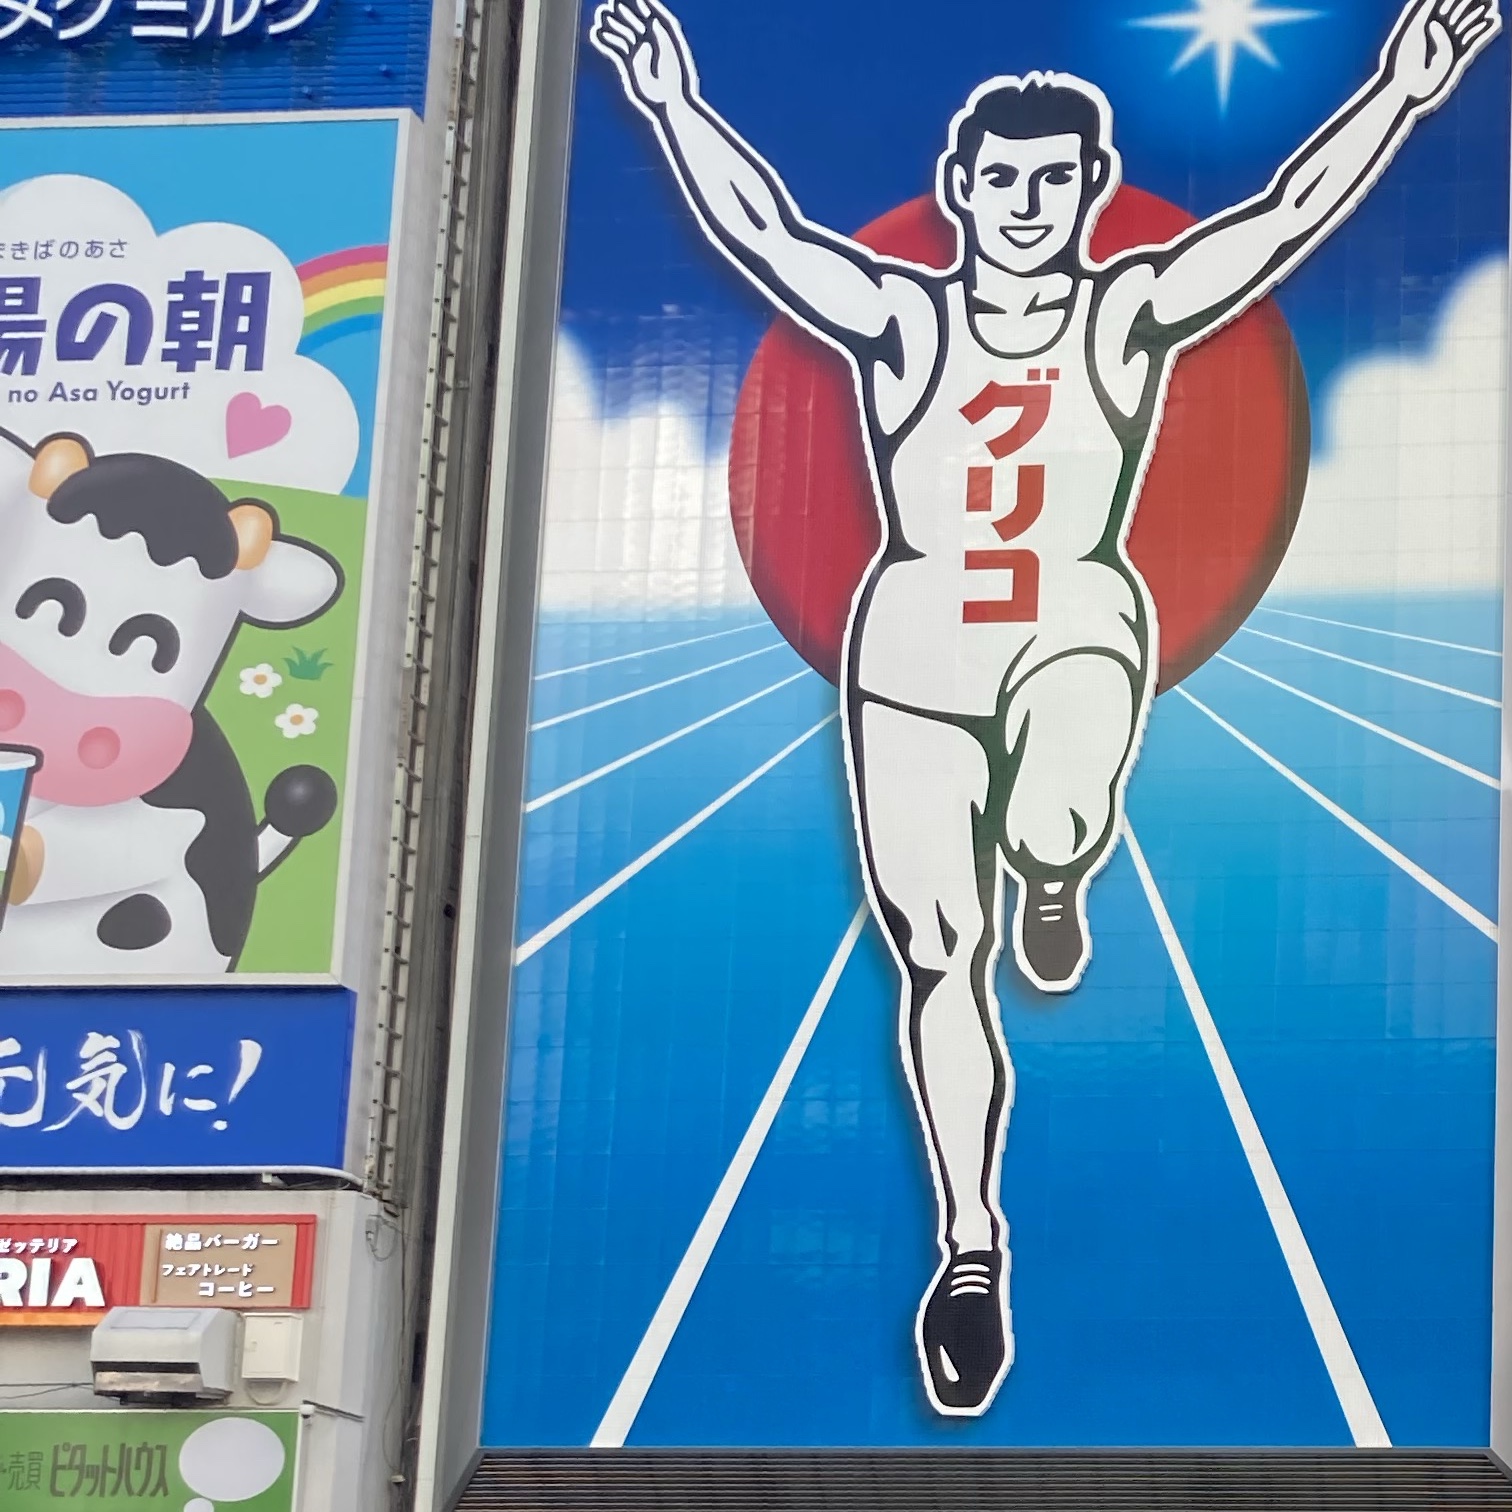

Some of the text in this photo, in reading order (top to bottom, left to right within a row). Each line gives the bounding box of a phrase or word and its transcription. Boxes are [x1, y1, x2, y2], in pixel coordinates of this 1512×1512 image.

[8, 380, 191, 405] no Asa Yogurt
[958, 368, 1060, 623] グリコ
[162, 1262, 255, 1277] フェアトレード
[199, 1281, 276, 1297] コーヒー
[50, 1441, 169, 1498] ピタットハウス
